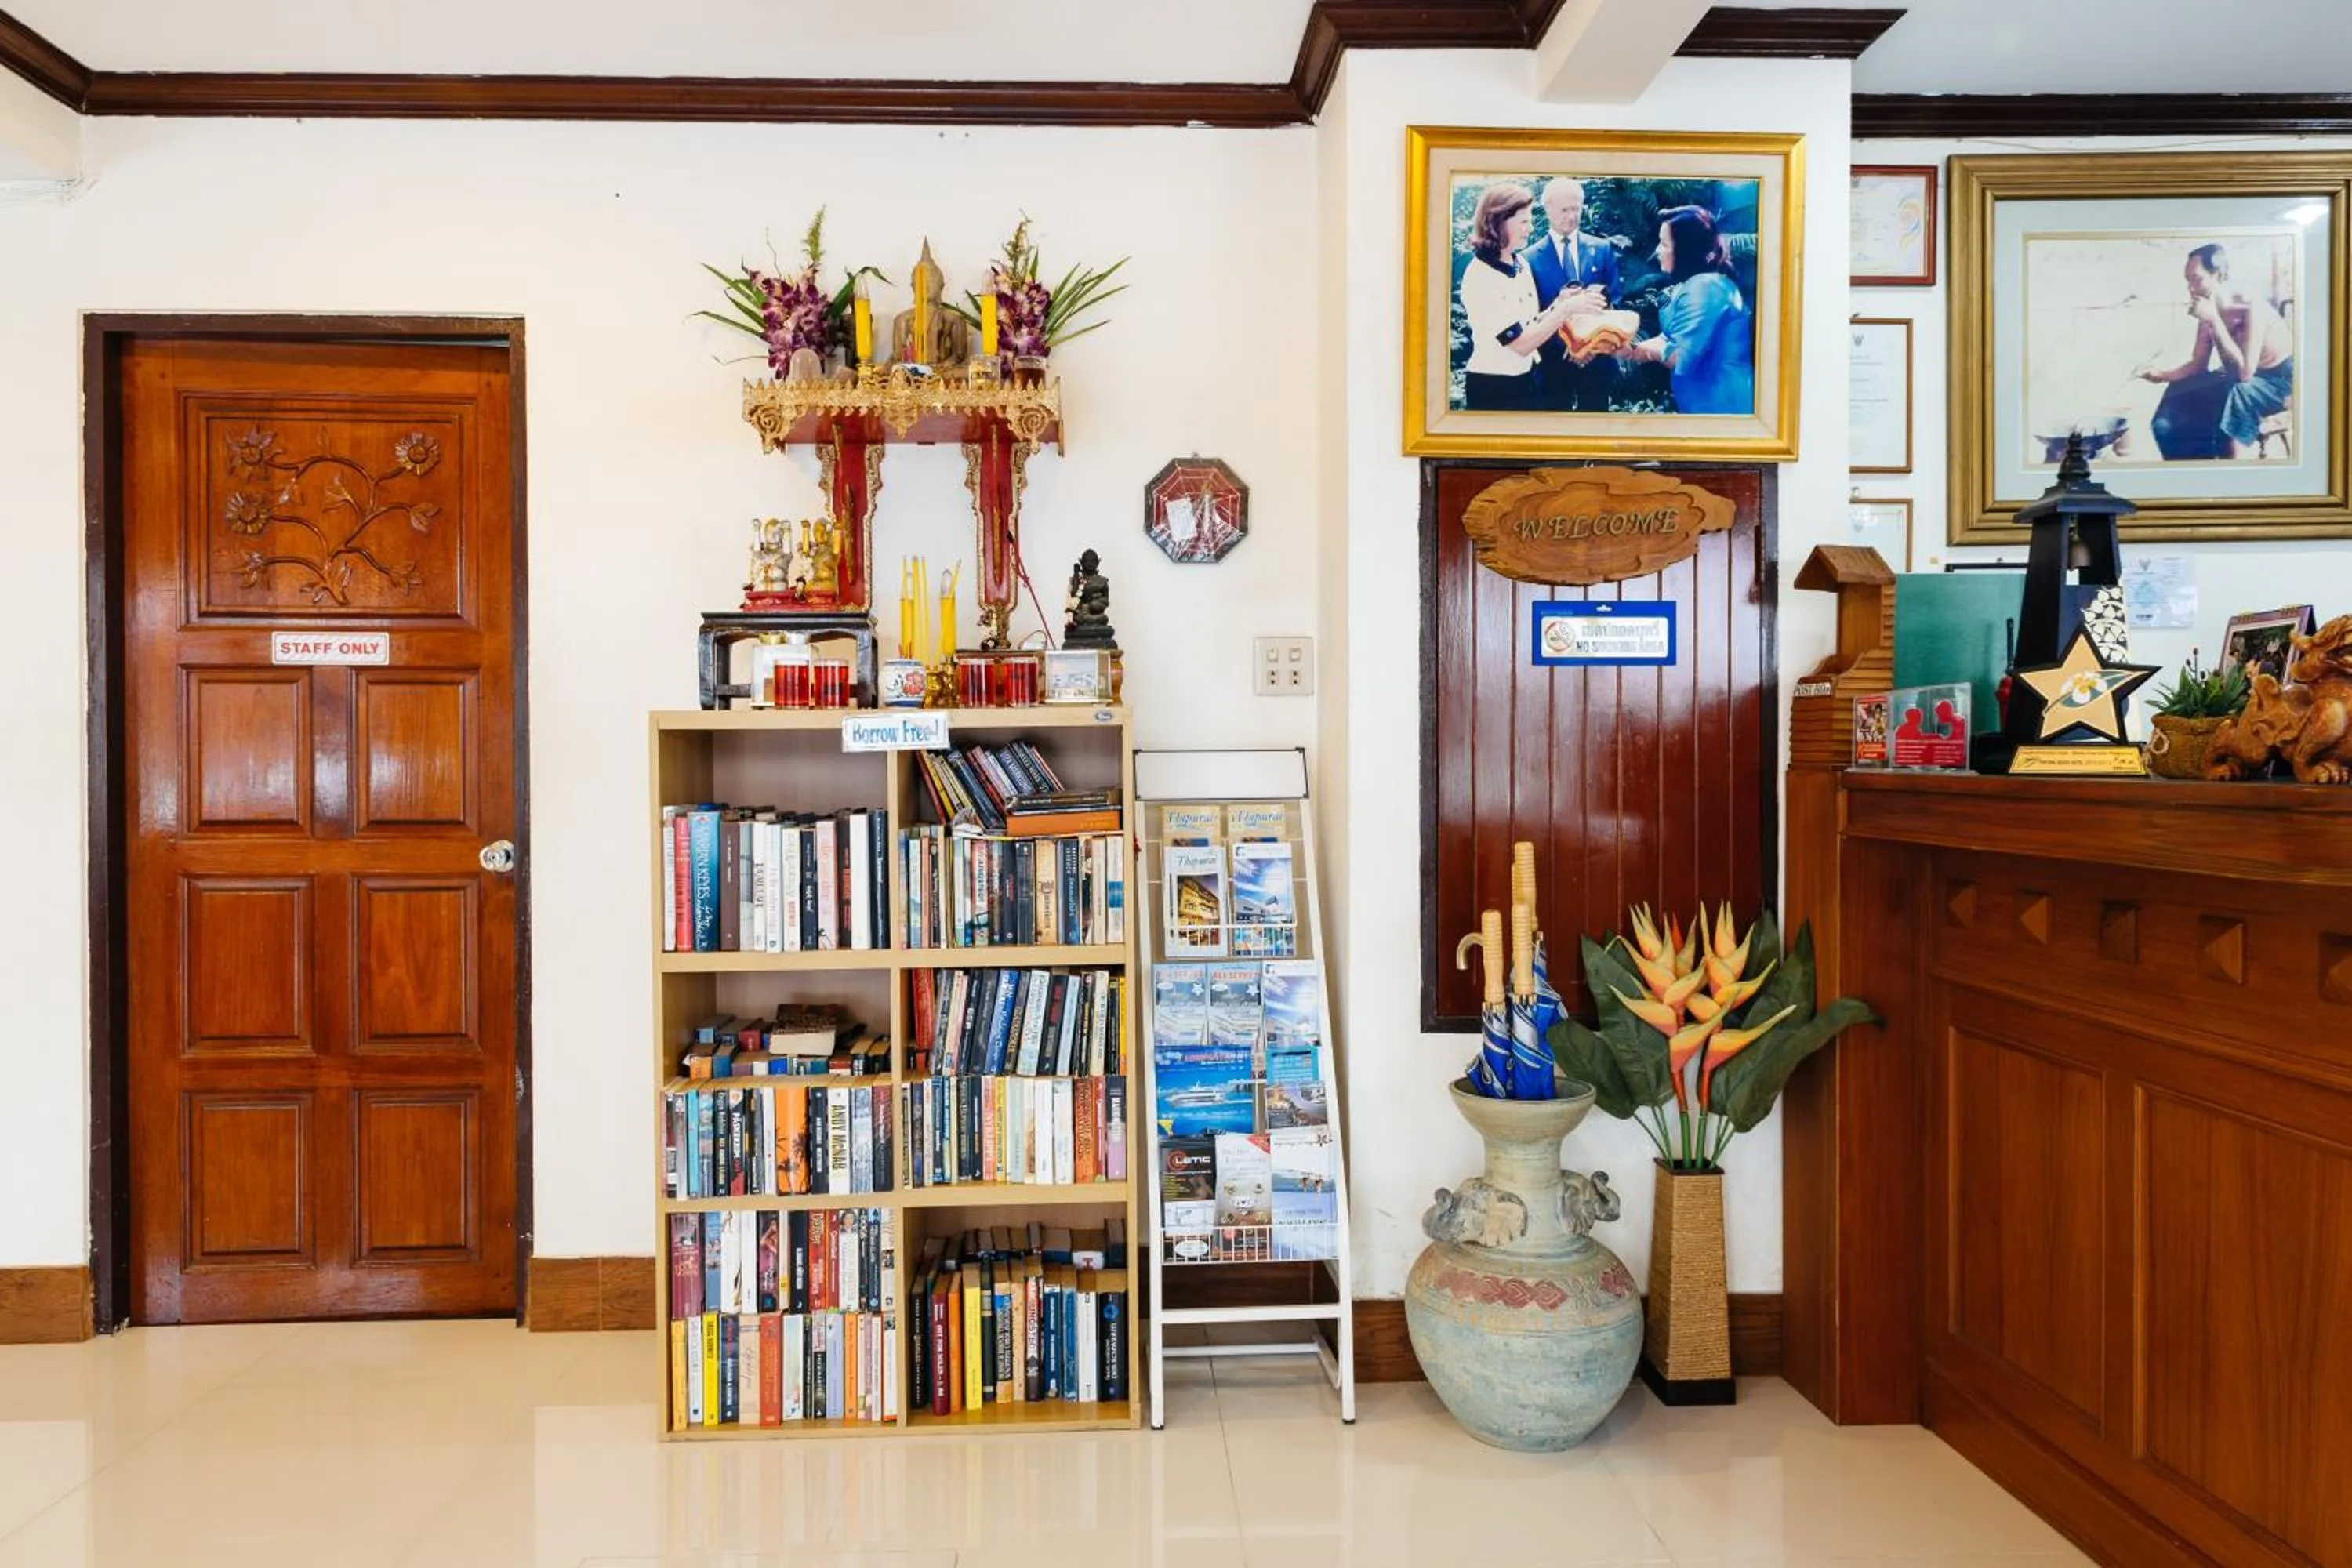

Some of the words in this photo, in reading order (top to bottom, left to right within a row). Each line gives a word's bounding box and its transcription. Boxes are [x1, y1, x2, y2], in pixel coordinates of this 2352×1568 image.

[1513, 506, 1679, 542] WELCOME
[281, 642, 332, 655] STAFF
[339, 642, 379, 655] ONLY
[1577, 641, 1589, 653] NO
[852, 723, 898, 744] Borrow
[695, 868, 710, 900] KEYES
[831, 1105, 848, 1131] ANDY
[831, 1134, 848, 1170] McNAB
